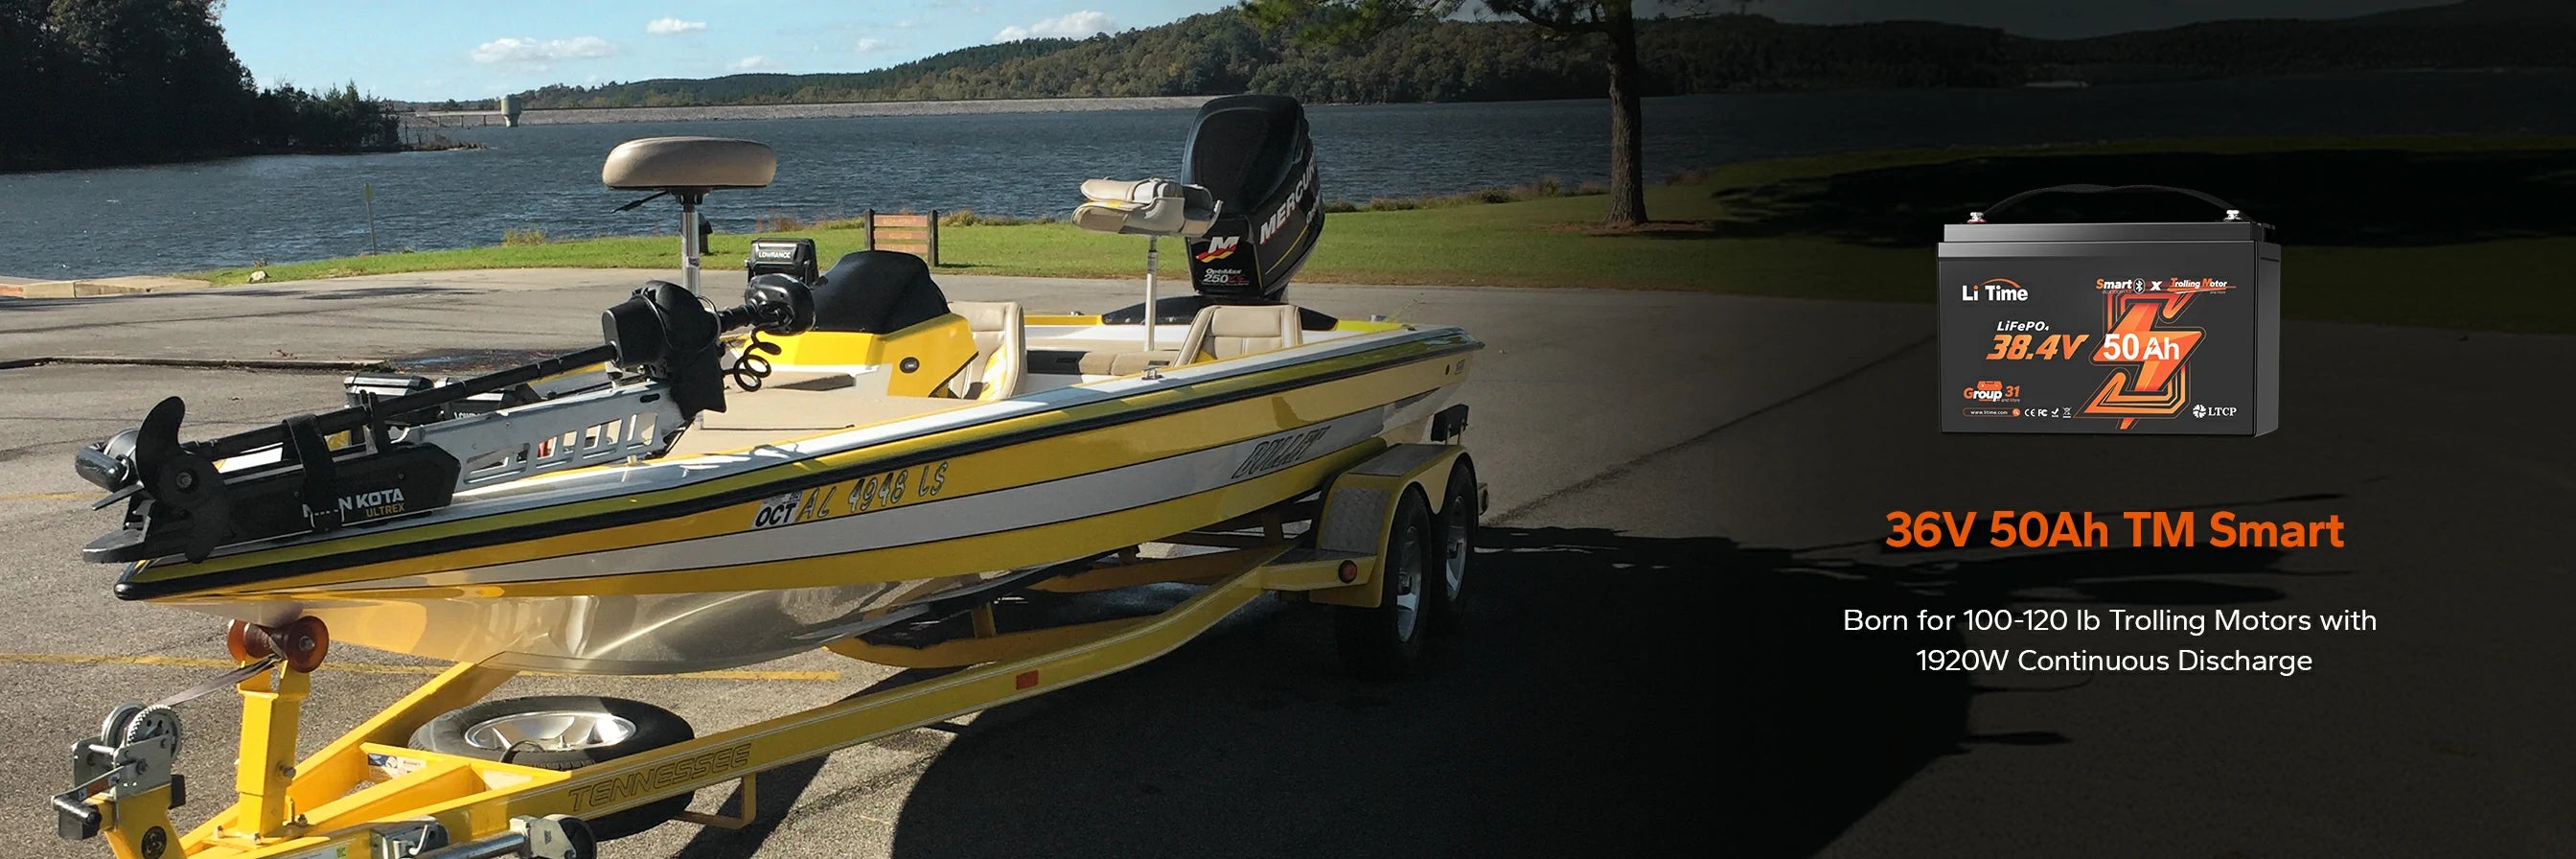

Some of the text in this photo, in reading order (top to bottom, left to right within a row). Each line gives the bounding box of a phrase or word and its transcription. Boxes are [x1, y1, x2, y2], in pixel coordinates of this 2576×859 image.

[1259, 151, 1316, 245] MERCUR
[1962, 285, 2029, 301] Li Time
[2096, 278, 2132, 290] Smart
[2170, 277, 2200, 290] Trolling
[2200, 278, 2228, 288] Motor
[1986, 334, 2090, 360] 38.4V
[1963, 385, 2020, 402] Group 31
[2208, 406, 2238, 416] LTCP
[847, 469, 908, 514] 4948
[917, 460, 949, 498] LS
[356, 488, 404, 509] KOTA
[366, 502, 405, 518] ULTREX
[754, 502, 797, 527] OCT
[568, 742, 752, 812] TENNESSEE
